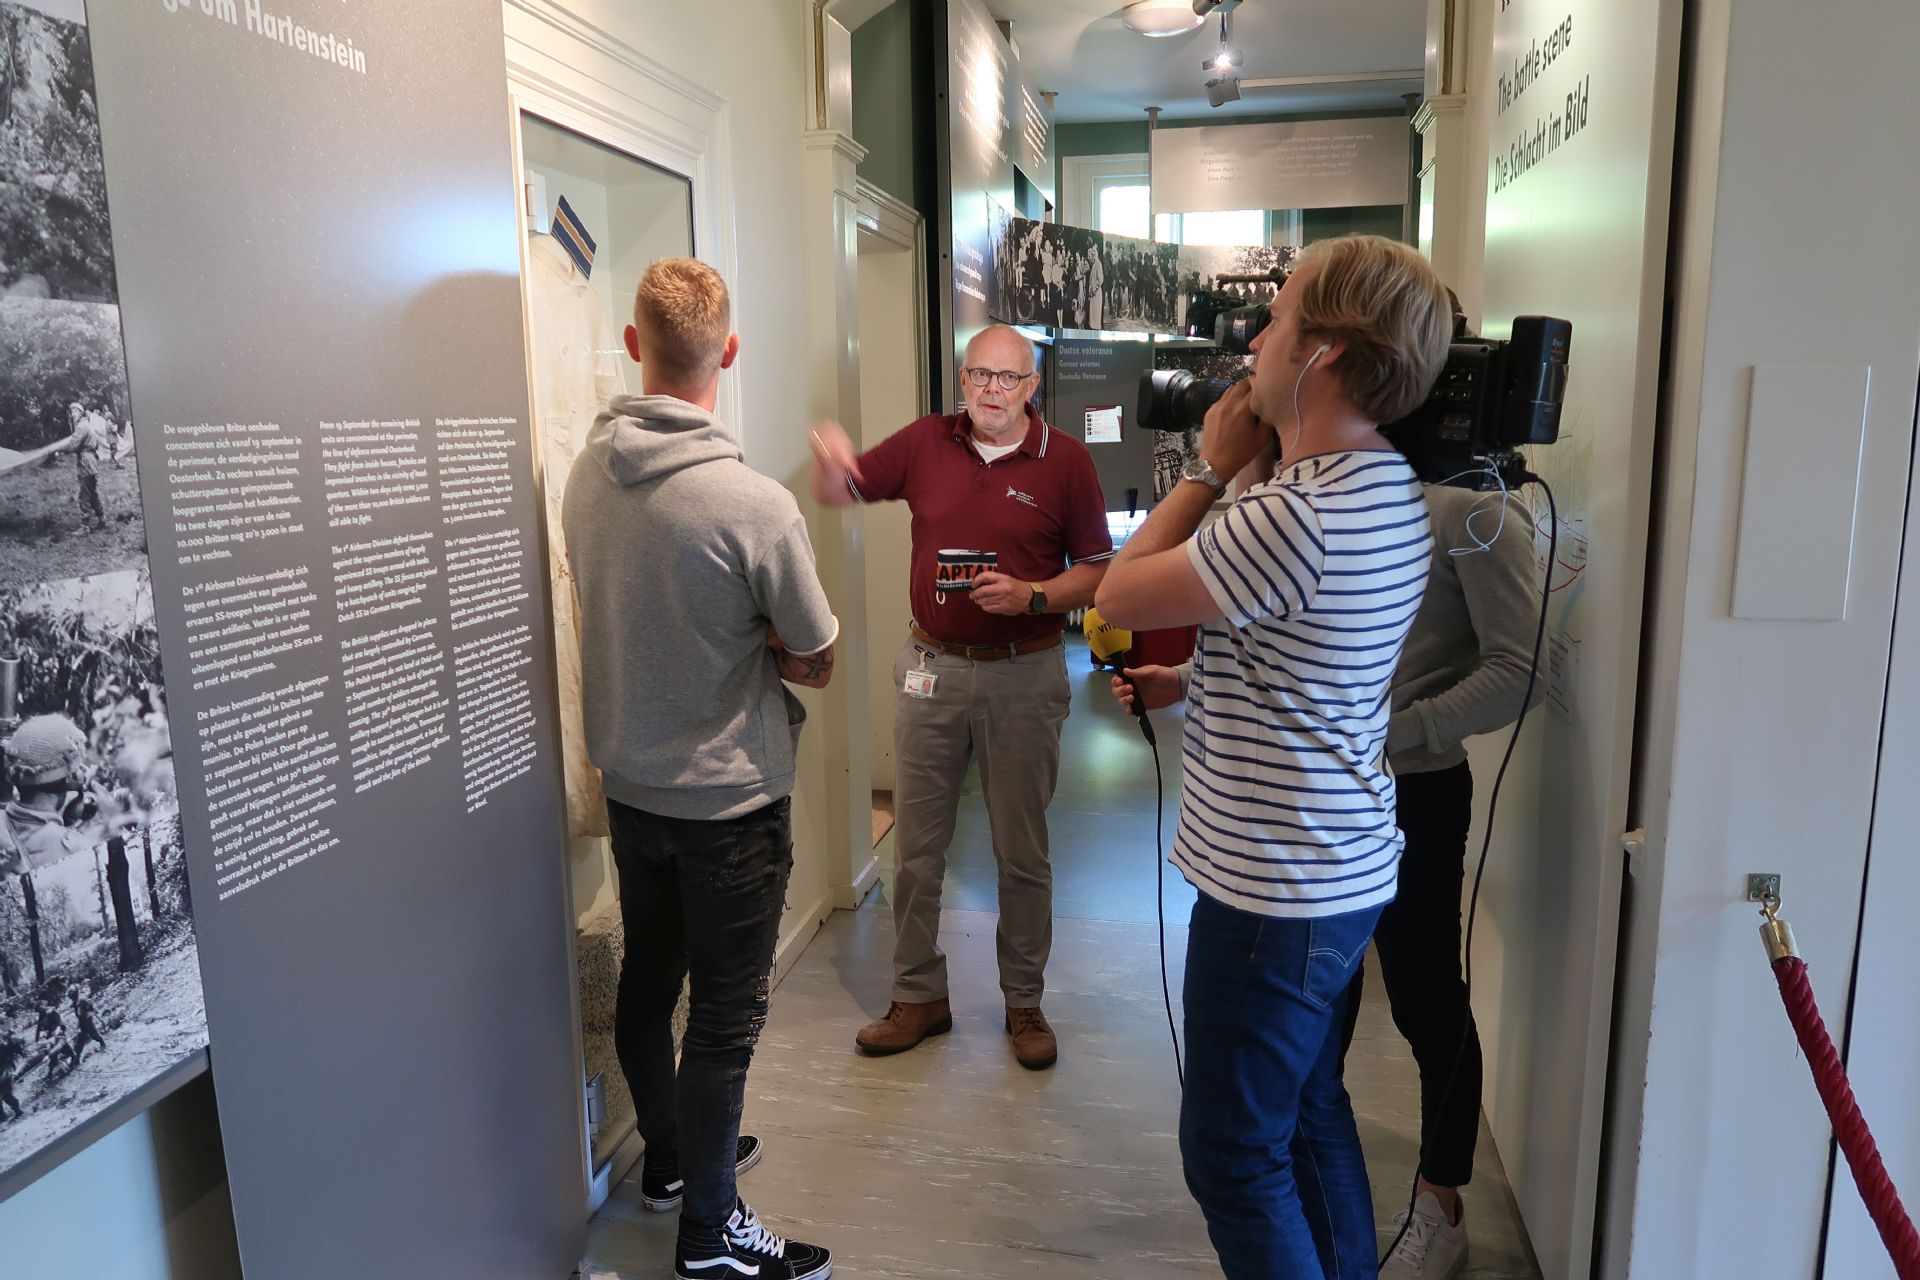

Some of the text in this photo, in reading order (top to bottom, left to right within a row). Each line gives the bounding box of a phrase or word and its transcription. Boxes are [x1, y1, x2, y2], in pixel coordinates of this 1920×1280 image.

[245, 0, 367, 74] Hartenstein
[1498, 14, 1573, 116] The battle scene
[1494, 74, 1590, 194] Die Schlacht im Bild
[1059, 345, 1113, 355] Duitse veteranen
[164, 422, 279, 435] De overgebleven Britse eenheden
[166, 442, 214, 450] concentreren
[216, 438, 230, 448] zich
[232, 437, 251, 447] vanaf
[261, 437, 293, 448] september
[295, 436, 302, 444] in
[168, 457, 177, 467] de
[218, 455, 226, 464] de
[285, 451, 299, 459] rond
[170, 472, 214, 483] Oosterbeek.
[216, 471, 225, 479] Ze
[227, 469, 253, 478] vechten
[255, 468, 275, 476] vanuit
[172, 488, 229, 499] schuttersputten
[173, 506, 214, 516] loopgraven
[216, 501, 243, 510] rondom
[244, 499, 256, 508] het
[175, 523, 187, 531] Na
[188, 522, 206, 530] twee
[208, 519, 229, 529] dagen
[231, 516, 243, 526] zijn
[266, 512, 274, 520] de
[276, 511, 291, 519] ruim
[205, 535, 229, 544] Britten
[231, 533, 244, 542] nog
[280, 525, 287, 533] in
[289, 524, 303, 532] staat
[179, 550, 231, 564] om te vechten.
[183, 587, 193, 596] De
[205, 581, 235, 591] Airborne
[237, 575, 264, 585] Division
[266, 569, 295, 580] verdedigt
[296, 566, 308, 575] zich
[184, 602, 205, 612] tegen
[207, 599, 220, 607] een
[221, 591, 257, 604] overmacht
[272, 581, 307, 596] grotendeels
[186, 616, 213, 627] ervaren
[254, 599, 286, 612] bewapend
[288, 597, 299, 605] met
[300, 593, 317, 602] tanks
[190, 650, 203, 658] van
[205, 646, 218, 655] een
[280, 624, 309, 636] eenheden
[199, 630, 220, 640] zware
[222, 622, 251, 635] artillerie.
[253, 617, 273, 627] Verder
[192, 655, 238, 674] uiteenlopend
[239, 654, 252, 662] van
[253, 643, 292, 657] Nederlandse
[313, 634, 322, 642] tot
[194, 682, 203, 690] en
[205, 677, 219, 686] met
[220, 673, 229, 682] de
[197, 676, 328, 720] De Britse bevoorrading wordt afgeworpen
[199, 691, 324, 737] op plaatsen die veelal in Duitse handen
[215, 863, 223, 871] te
[224, 852, 247, 866] weinig
[287, 824, 306, 840] gebrek
[308, 820, 318, 828] aan
[218, 829, 329, 885] voorraden en de toenemende Duitse
[220, 838, 340, 900] aanvalsdruk doen de Britten de das om.
